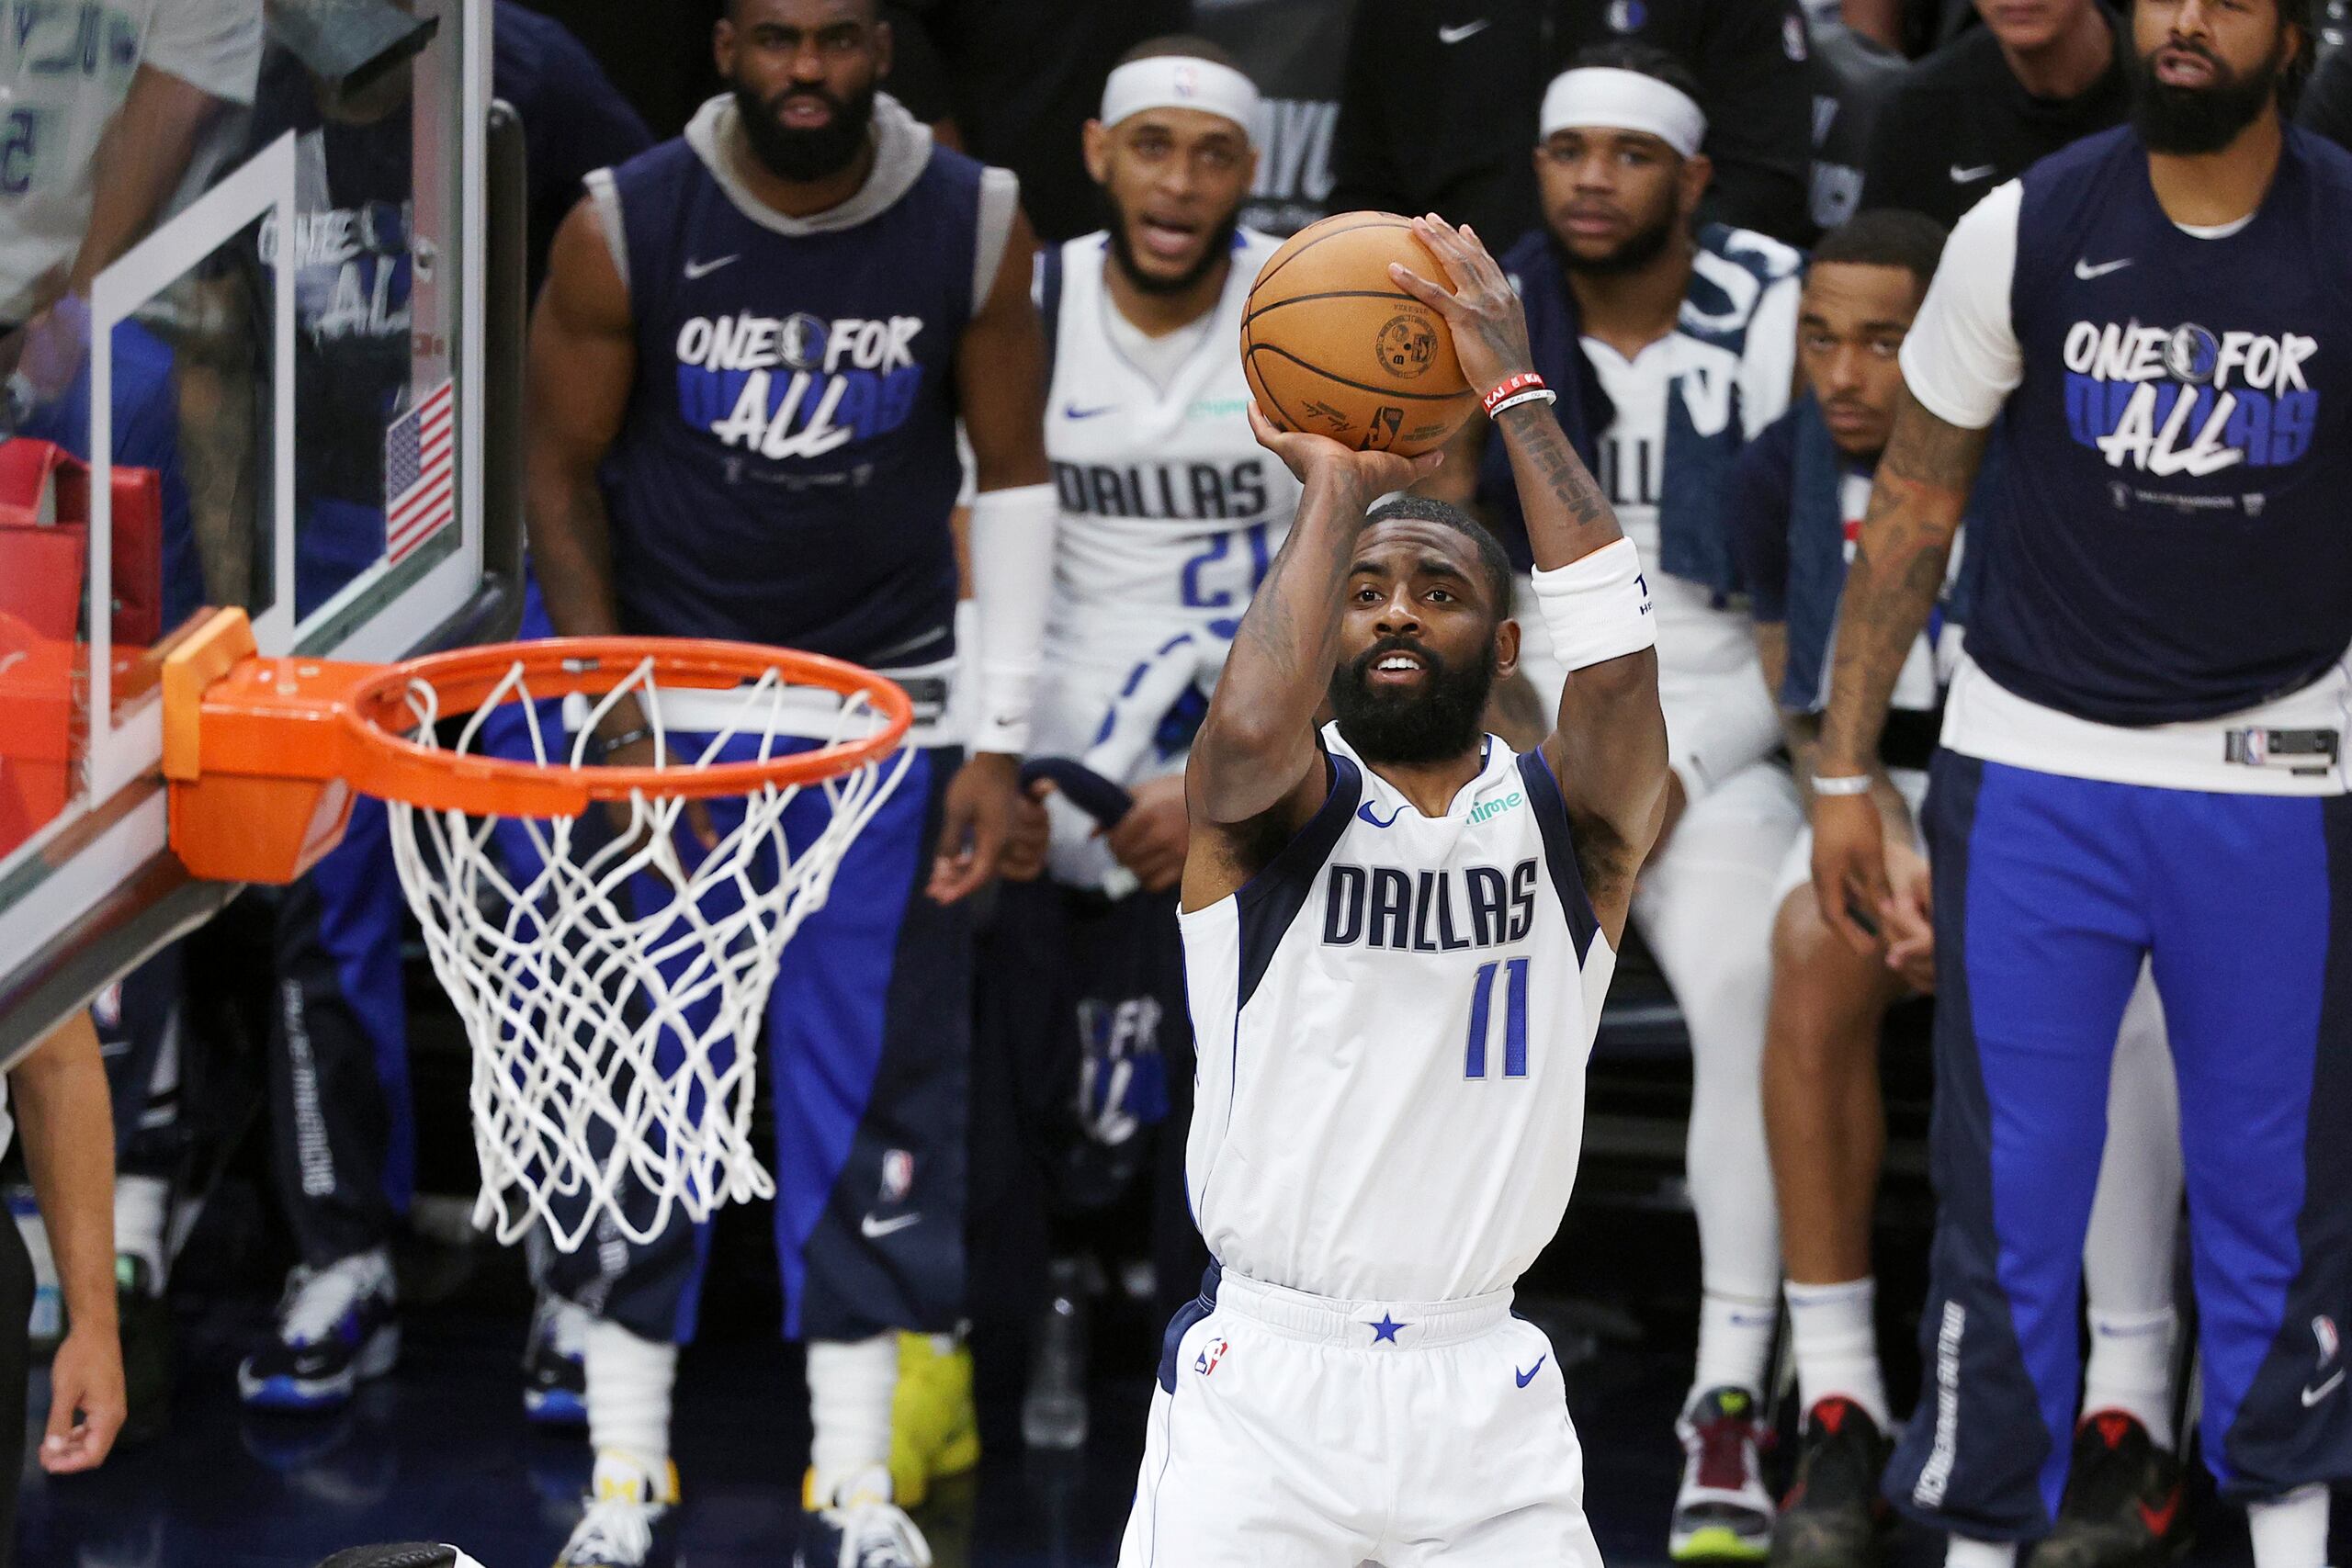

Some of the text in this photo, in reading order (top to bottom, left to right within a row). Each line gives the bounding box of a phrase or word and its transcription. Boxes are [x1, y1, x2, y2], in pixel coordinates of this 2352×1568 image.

[676, 310, 924, 376] ONE FOR
[2064, 320, 2319, 399] ONE FOR
[709, 368, 854, 460] ALL
[2096, 381, 2244, 477] ALL
[1053, 459, 1266, 518] DALLAS
[1321, 857, 1538, 954] DALLAS
[1464, 955, 1532, 1080] 11
